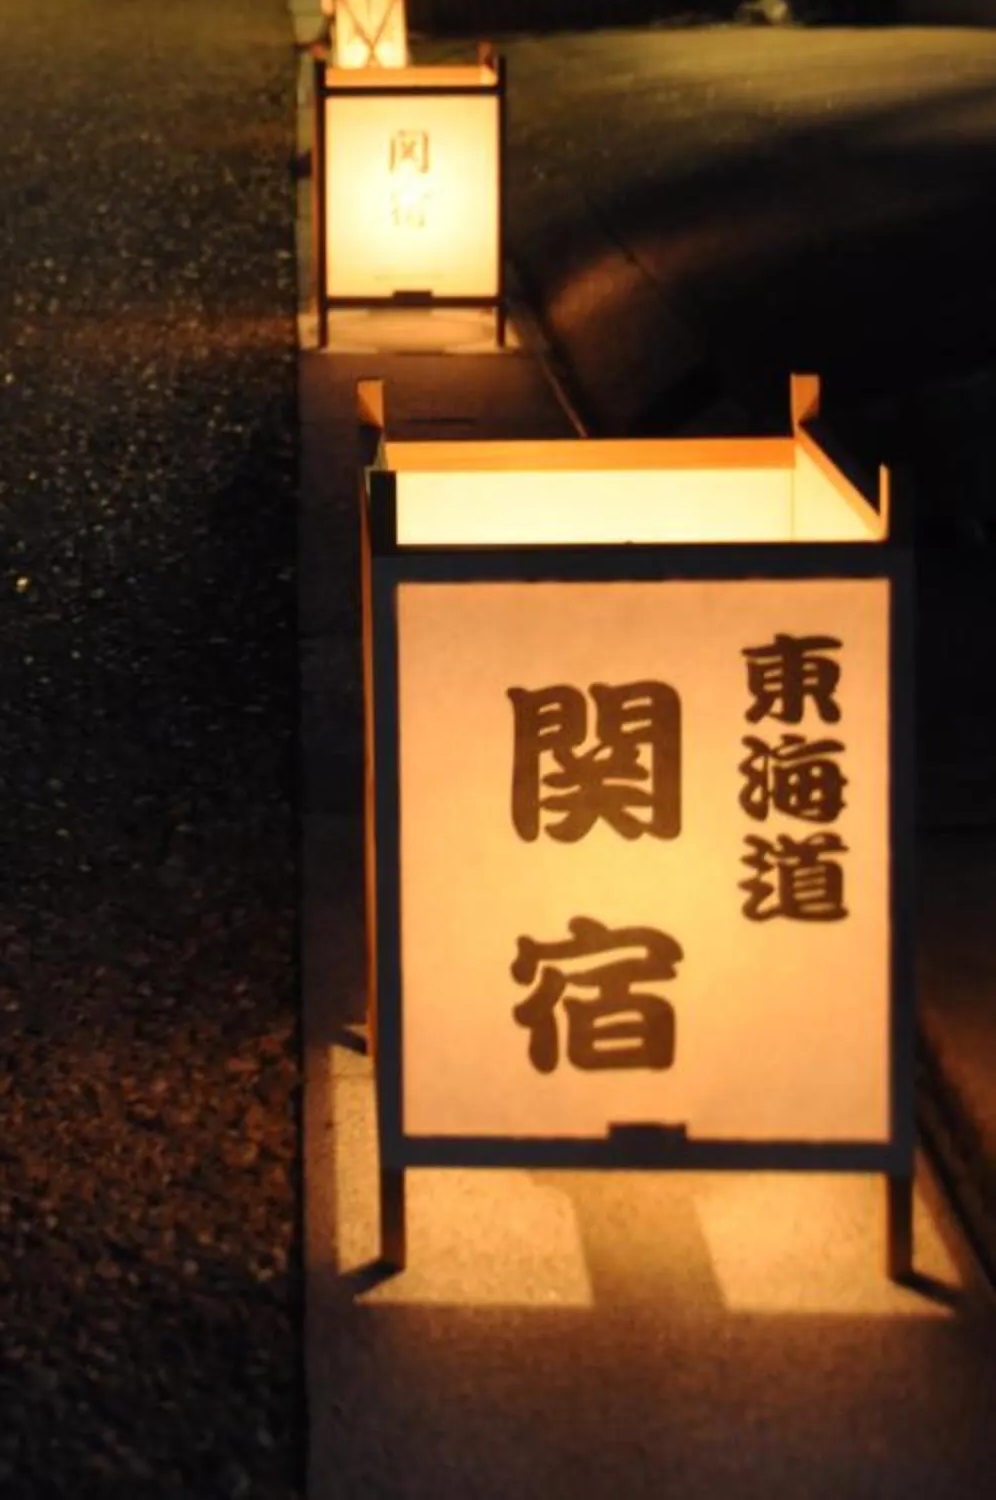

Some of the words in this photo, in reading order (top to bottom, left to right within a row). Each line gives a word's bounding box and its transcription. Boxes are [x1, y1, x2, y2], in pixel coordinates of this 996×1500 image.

[505, 679, 685, 1076] 関宿
[737, 633, 850, 924] 東海道
